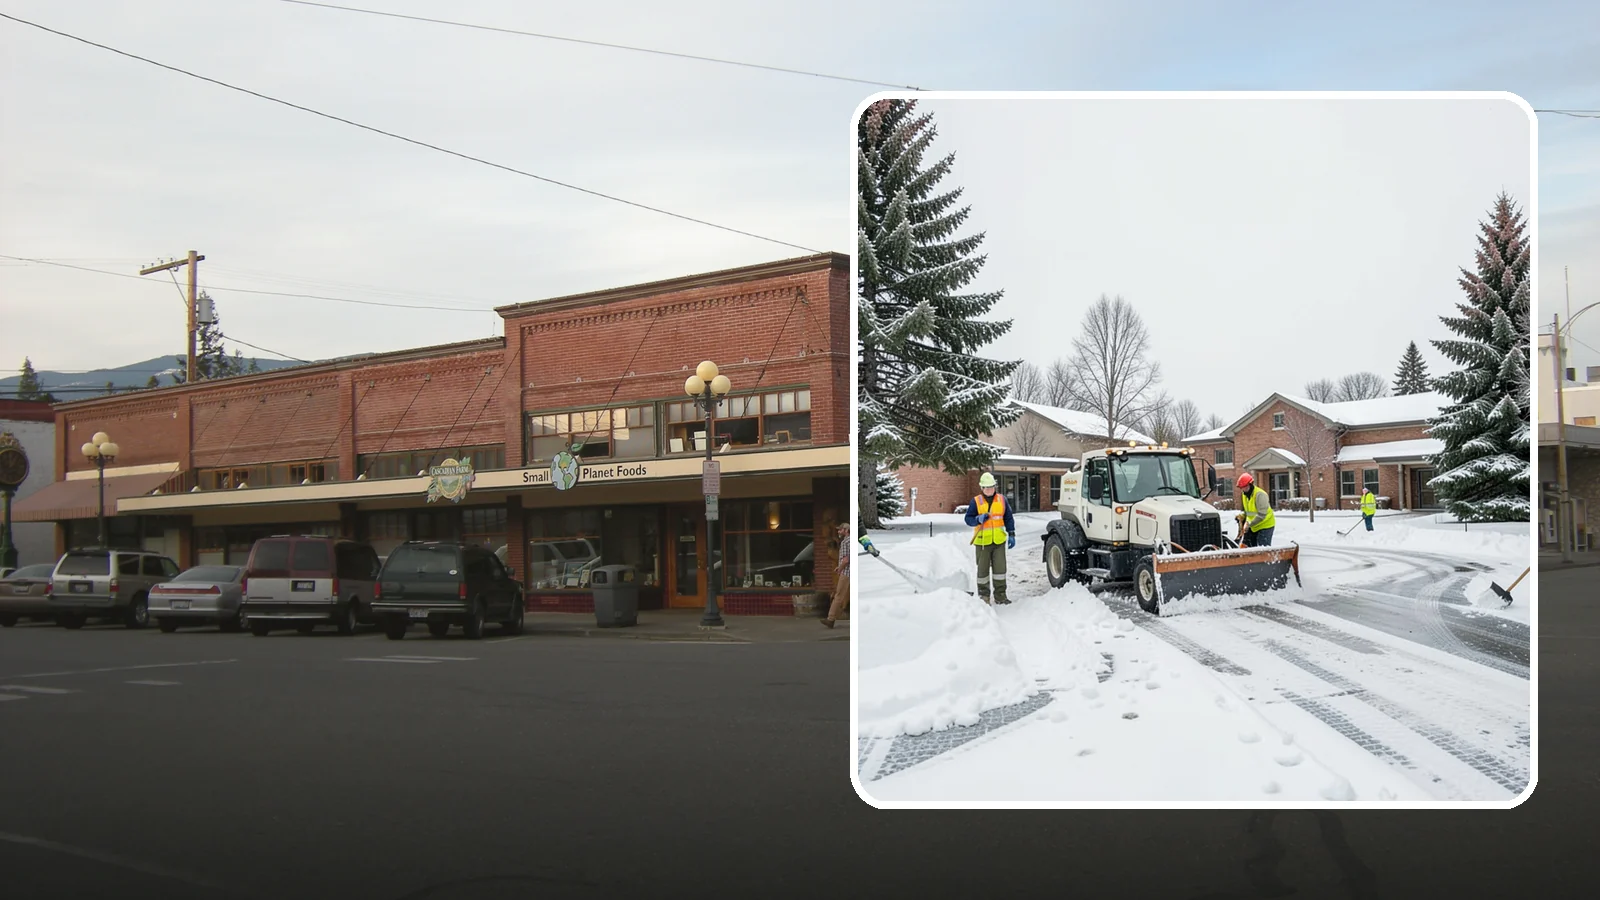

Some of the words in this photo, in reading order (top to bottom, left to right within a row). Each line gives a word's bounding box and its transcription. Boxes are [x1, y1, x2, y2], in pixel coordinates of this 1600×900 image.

[523, 471, 549, 482] Small
[582, 467, 614, 479] Planet
[617, 464, 647, 476] Foods
